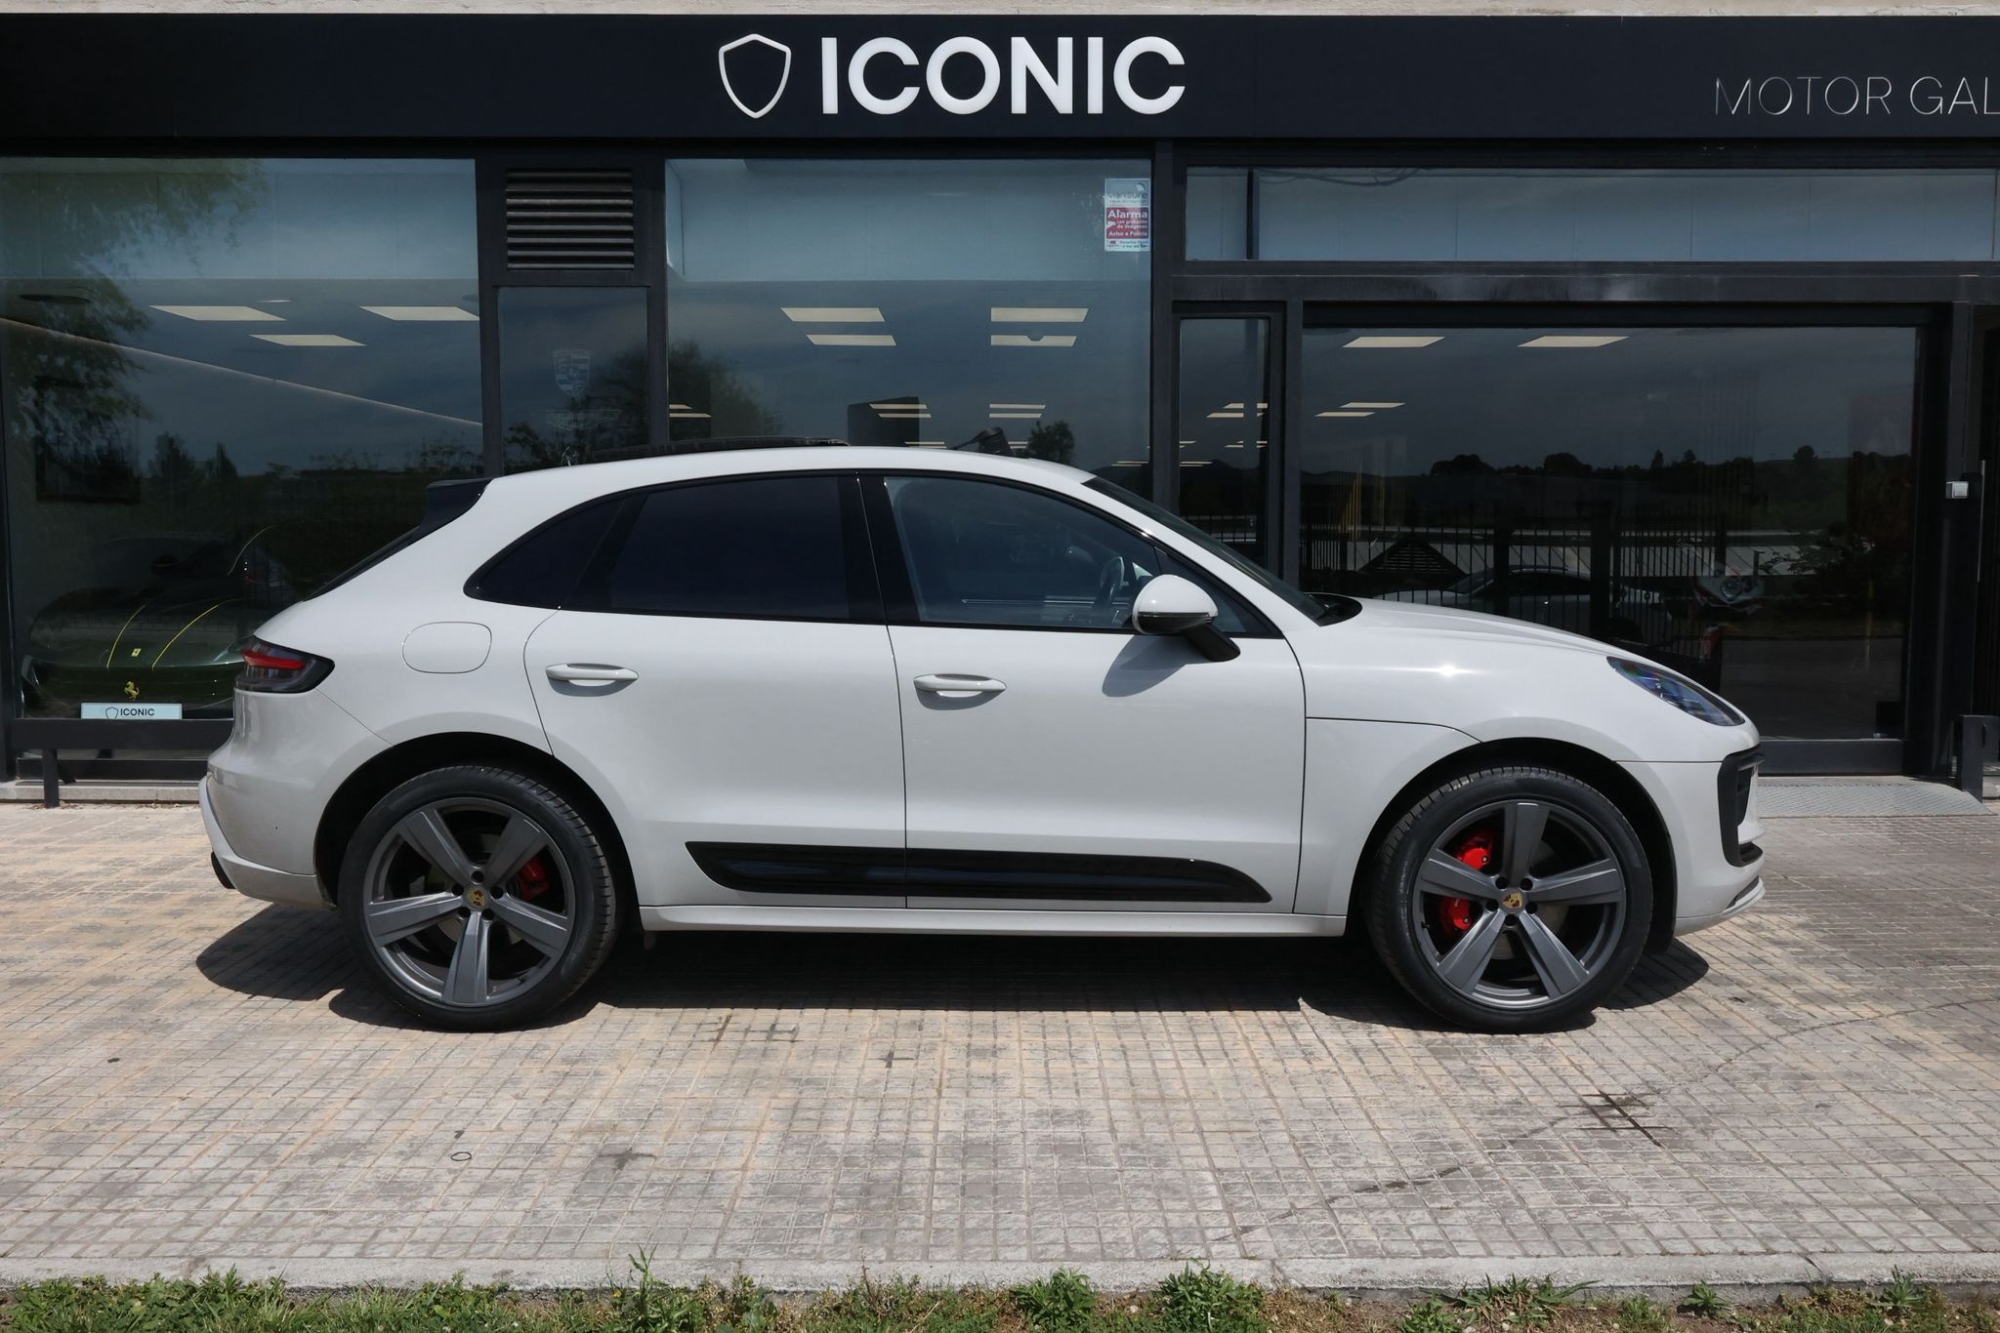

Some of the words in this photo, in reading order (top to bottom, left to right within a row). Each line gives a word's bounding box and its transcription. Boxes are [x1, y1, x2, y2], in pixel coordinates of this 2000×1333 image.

[821, 36, 1186, 115] ICONIC
[1715, 76, 1893, 116] MOTOR
[1909, 76, 2000, 116] GAL
[1108, 209, 1148, 218] Alarma
[120, 708, 155, 716] ICONIC
